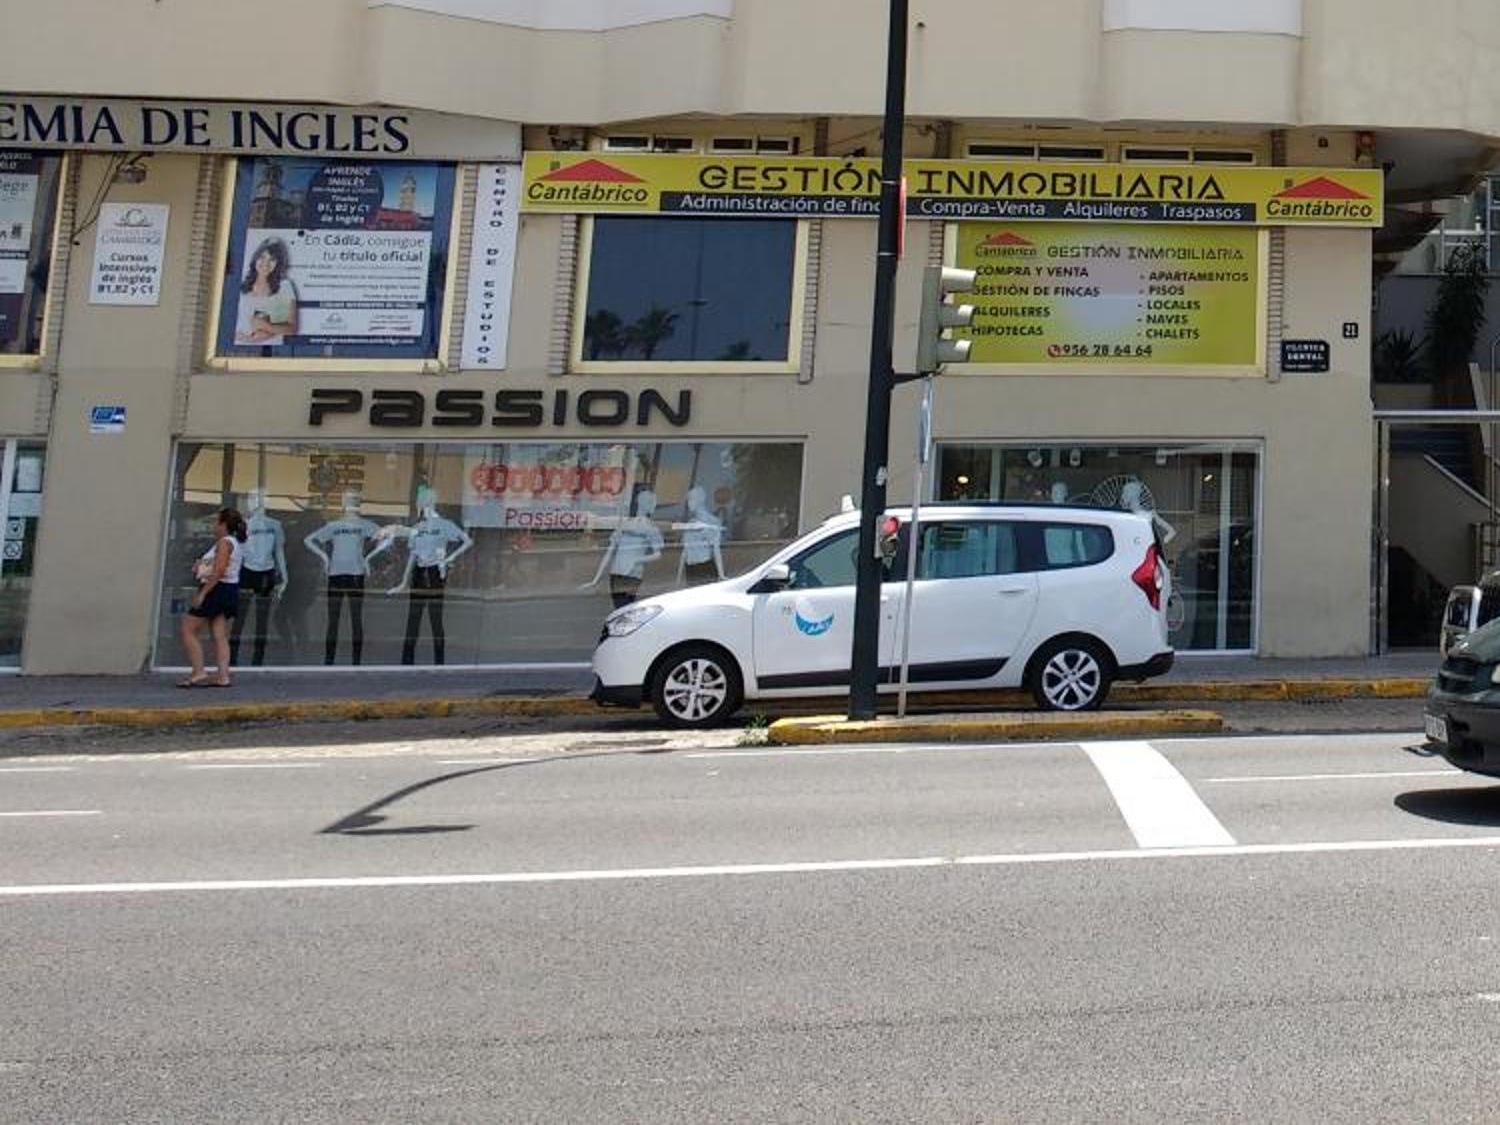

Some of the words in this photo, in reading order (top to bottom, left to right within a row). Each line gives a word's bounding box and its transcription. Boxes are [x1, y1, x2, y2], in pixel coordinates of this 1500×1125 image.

[142, 107, 210, 146] DE
[232, 110, 409, 153] INGLES
[699, 162, 886, 194] GESTIÓN
[916, 170, 1225, 200] INMOBILIARIA
[527, 182, 648, 204] Cantábrico
[680, 194, 819, 214] Administración
[823, 196, 846, 213] de
[920, 199, 1046, 217] Compra-Venta
[1063, 202, 1148, 220] Alquileres
[1160, 204, 1242, 221] Traspasos
[1266, 198, 1373, 219] Cantábrico
[305, 235, 320, 245] En
[368, 236, 424, 249] consigue
[323, 251, 337, 261] tu
[381, 251, 423, 262] oficial
[1047, 243, 1121, 260] GESTIÓN
[1127, 247, 1245, 261] INMOBILIARIA
[975, 266, 1031, 277] COMPRA
[1034, 266, 1042, 276] Y
[1047, 267, 1089, 278] VENTA
[1149, 271, 1249, 282] APARTAMENTOS
[1033, 286, 1050, 296] DE
[1053, 286, 1100, 298] FINCAS
[1148, 286, 1185, 296] PISOS
[1146, 300, 1200, 311] LOCALES
[1145, 315, 1188, 325] NAVES
[971, 325, 1044, 337] HIPOTECAS
[1145, 329, 1200, 340] CHALETS
[1113, 345, 1132, 356] 64
[1135, 345, 1152, 356] 64
[505, 507, 589, 527] Passion
